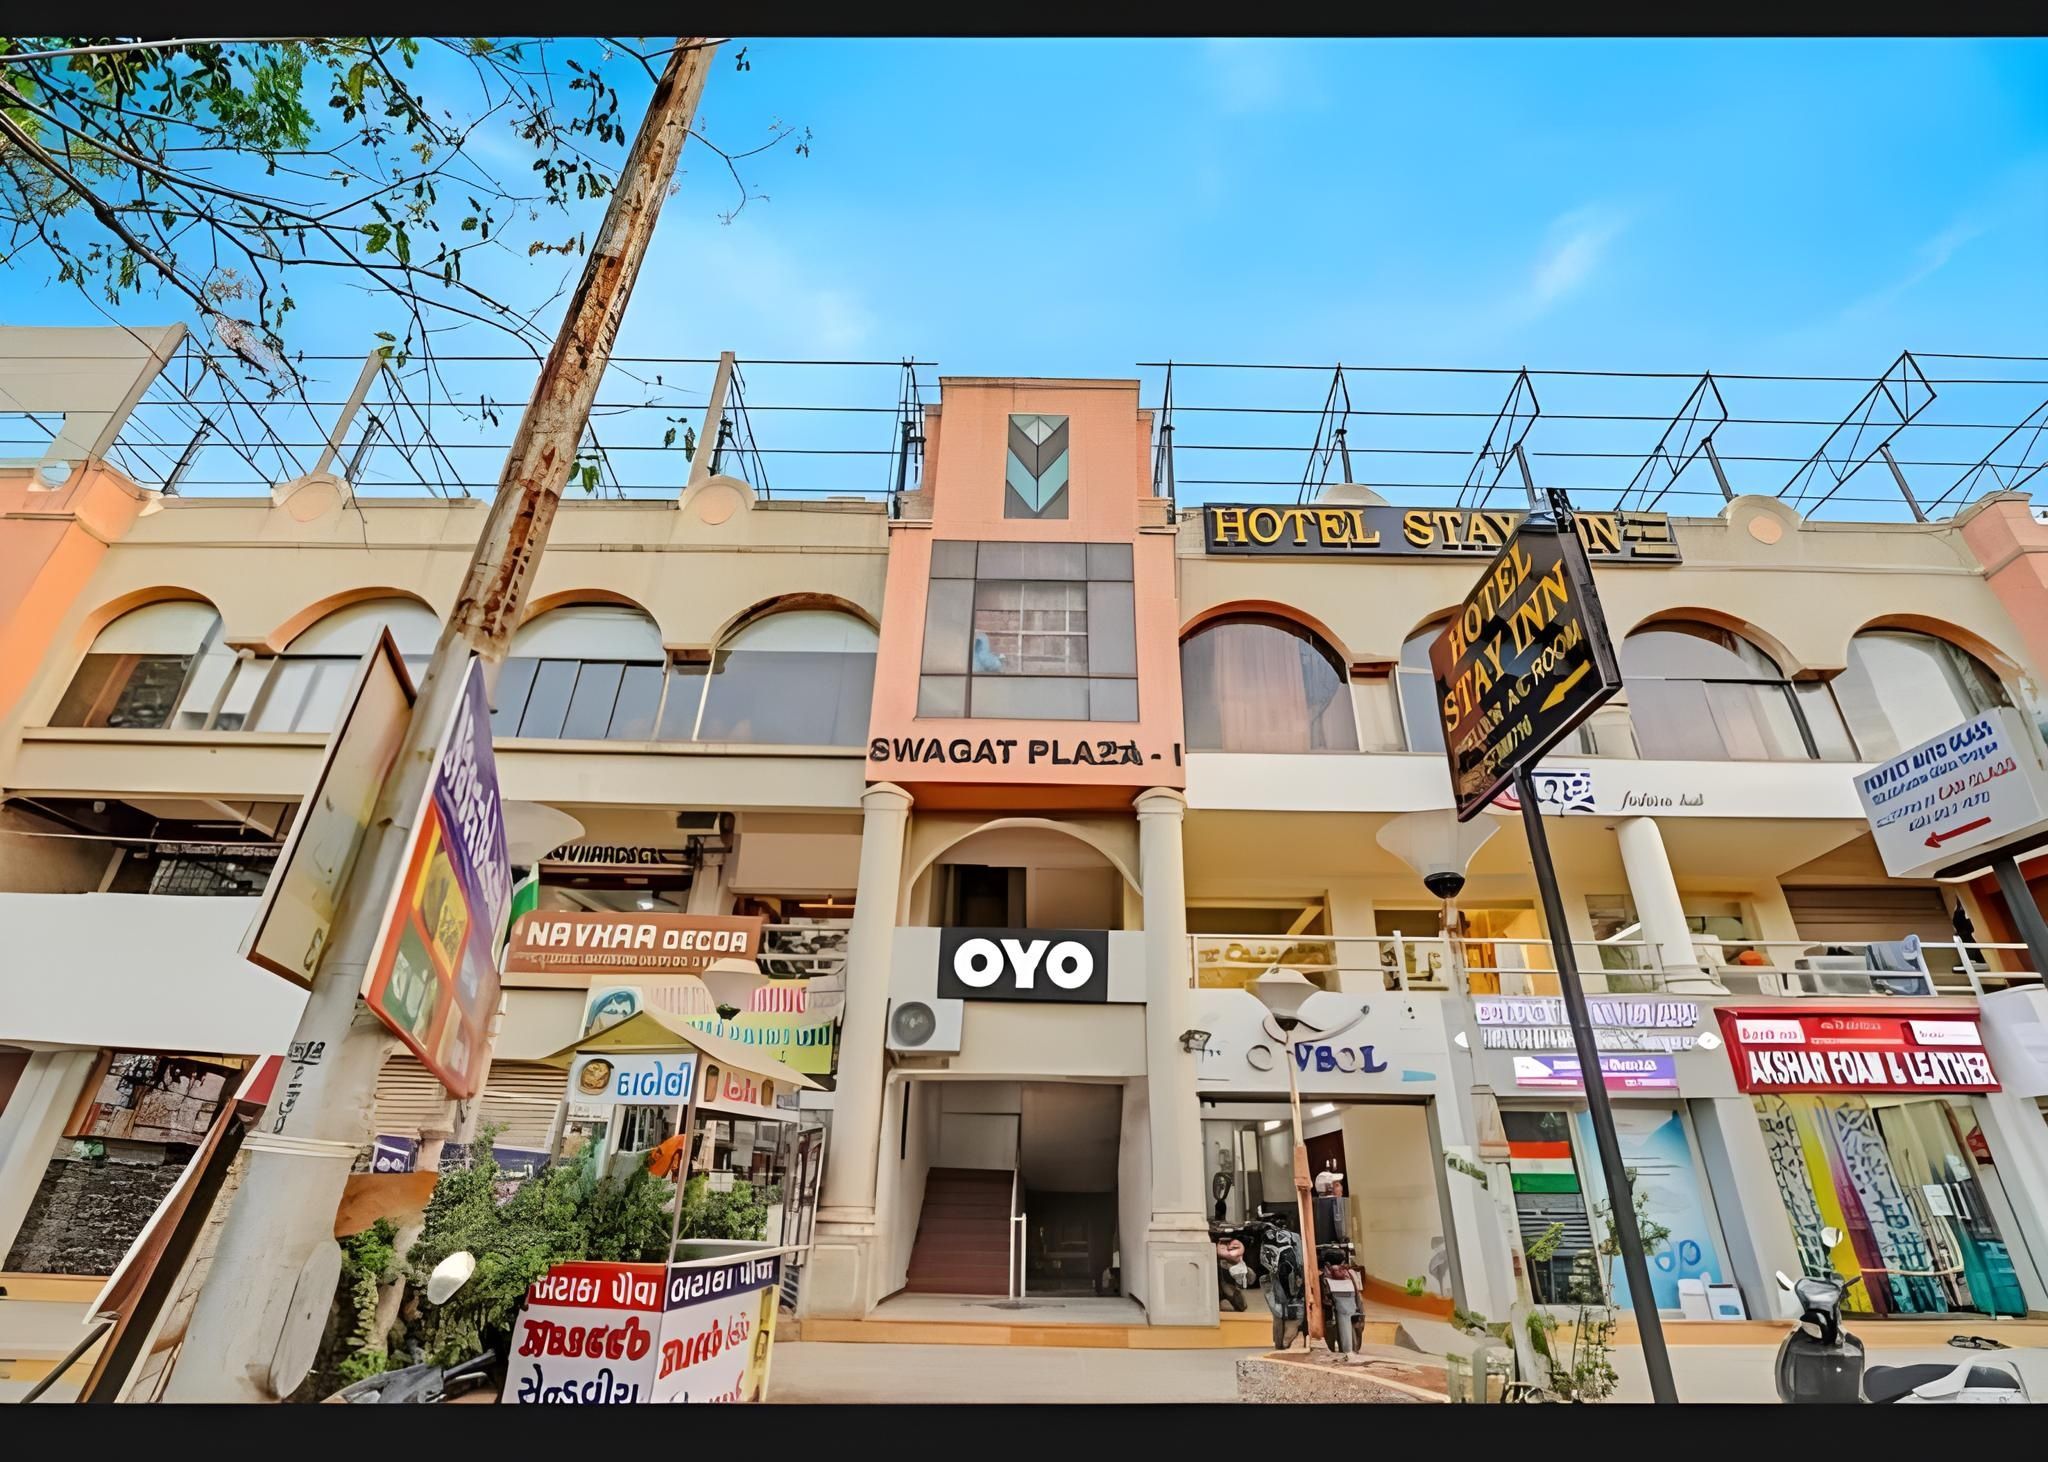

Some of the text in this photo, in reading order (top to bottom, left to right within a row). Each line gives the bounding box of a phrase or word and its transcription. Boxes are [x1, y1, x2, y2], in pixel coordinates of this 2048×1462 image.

[1213, 507, 1380, 547] HOTEL
[1403, 510, 1519, 550] STAY
[1449, 538, 1532, 668] HOTEL
[1443, 628, 1505, 733] STAY
[1507, 558, 1570, 660] INN
[869, 737, 1018, 764] SWAGAT
[953, 937, 1094, 990] OYO
[1750, 1051, 1831, 1085] AKSHAR
[1829, 1051, 1888, 1085] FOAM
[1903, 1052, 1998, 1086] LEATHER
